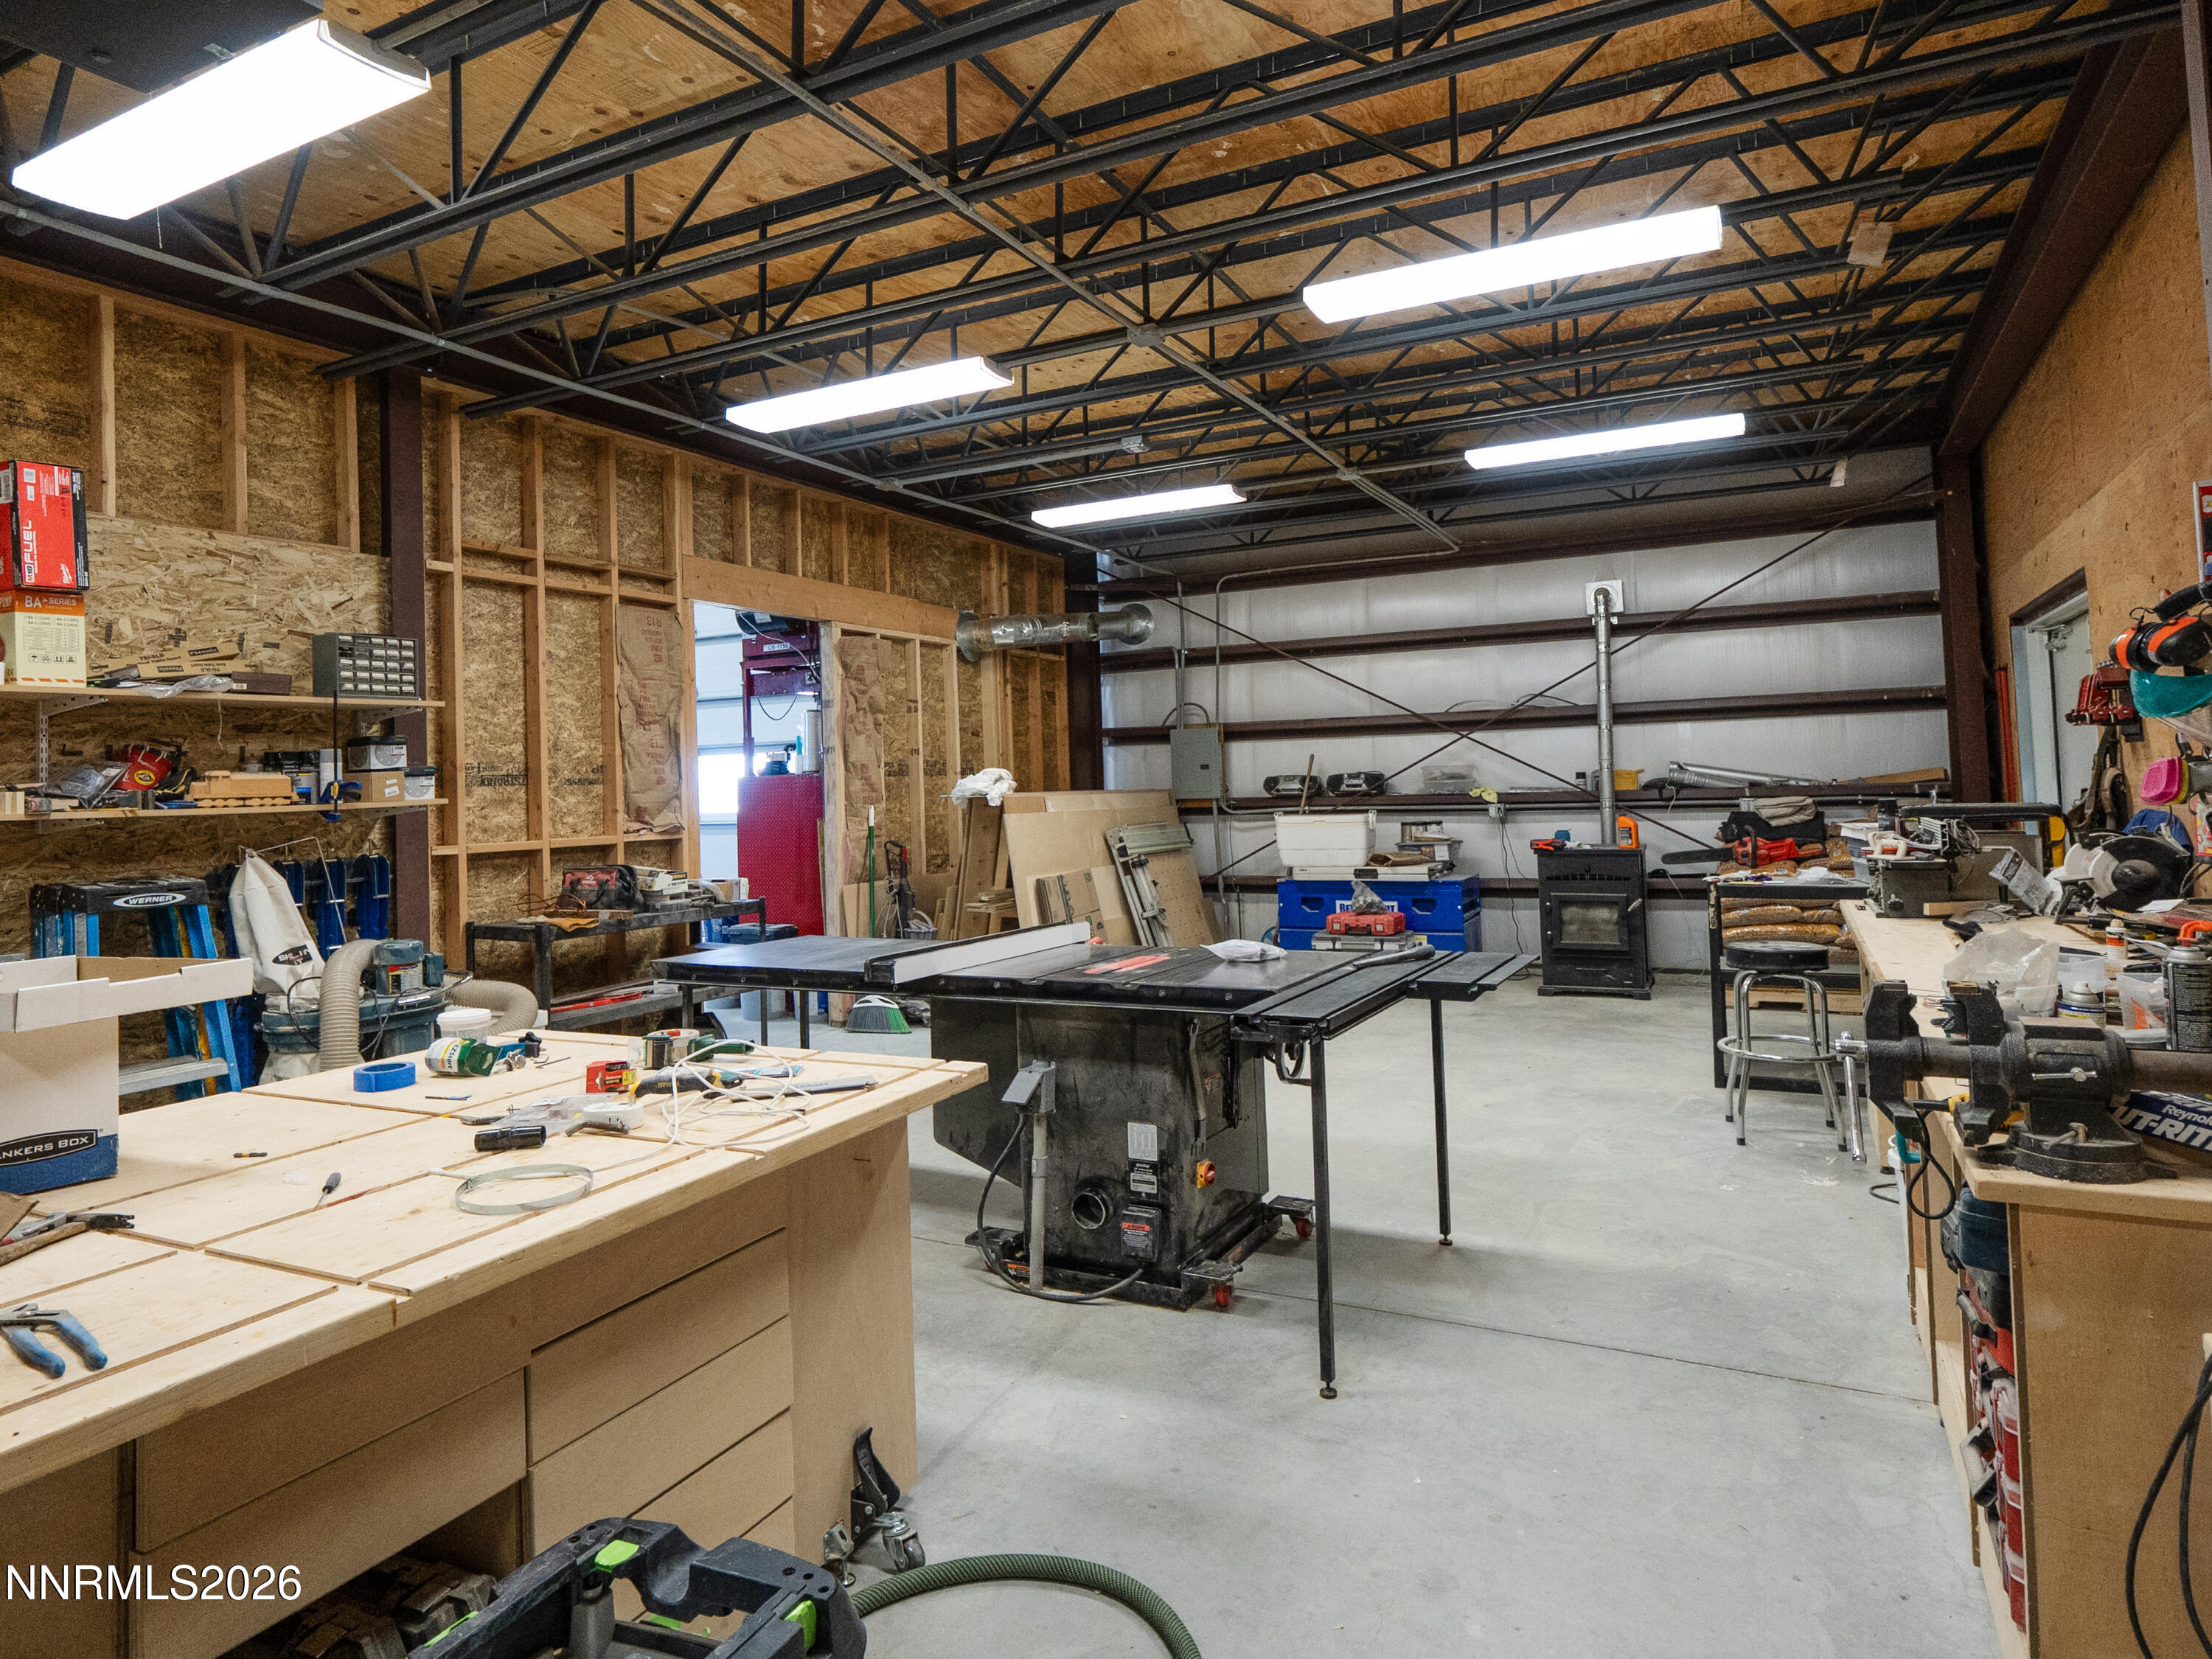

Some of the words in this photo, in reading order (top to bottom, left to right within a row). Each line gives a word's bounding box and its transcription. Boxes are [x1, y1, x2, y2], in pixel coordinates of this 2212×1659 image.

[23, 520, 34, 563] FUEL
[26, 565, 34, 582] M18
[25, 595, 42, 608] BA
[49, 597, 77, 606] SERIES
[128, 895, 173, 905] WERNER
[2112, 1105, 2212, 1151] UT-RIT
[0, 1143, 54, 1160] NKERS
[58, 1136, 89, 1149] BOX
